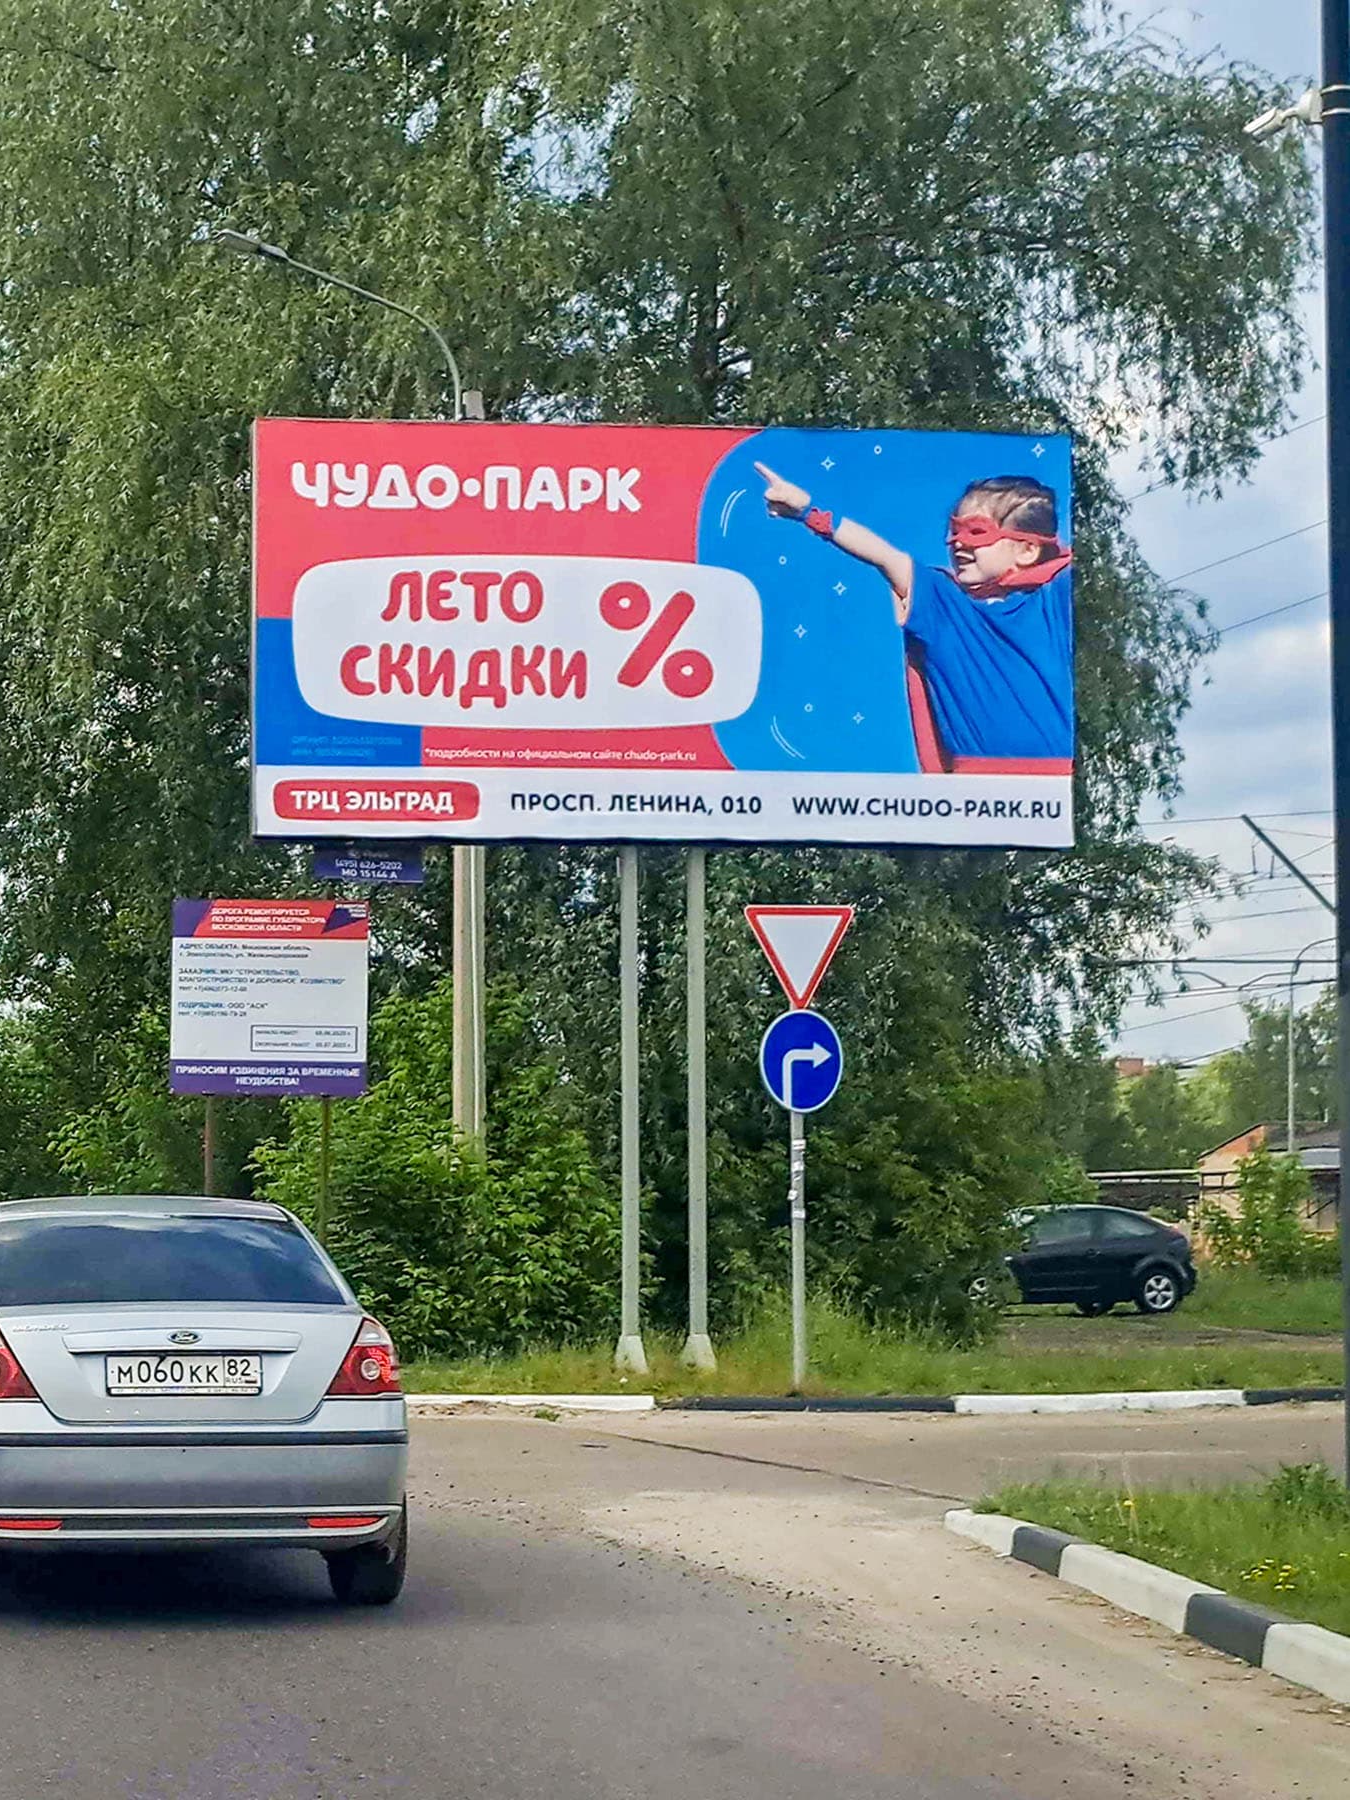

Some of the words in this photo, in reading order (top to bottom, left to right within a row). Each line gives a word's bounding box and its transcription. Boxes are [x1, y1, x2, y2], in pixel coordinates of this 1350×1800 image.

[381, 570, 544, 623] ЛЕТО
[599, 581, 714, 698] %
[340, 643, 587, 709] СКИДКИ
[502, 750, 515, 759] на
[517, 749, 592, 762] официальном
[593, 749, 622, 760] сайте
[624, 749, 697, 762] chudo-park.ru
[290, 790, 340, 813] ТРЦ
[344, 790, 454, 814] ЭЛЬГРАД
[510, 793, 602, 812] ПРОСП.
[608, 794, 714, 817] ЛЕНИНА,
[720, 795, 763, 814] 010
[792, 796, 1063, 819] WWW.CHUDO-PARK.RU
[175, 1065, 227, 1074] ПРИНОСИМ
[229, 1066, 286, 1075] ИЗВИНЕНИЯ
[287, 1067, 300, 1075] ЗА
[301, 1067, 360, 1077] ВРЕМЕННЫЕ
[227, 1359, 251, 1377] 82
